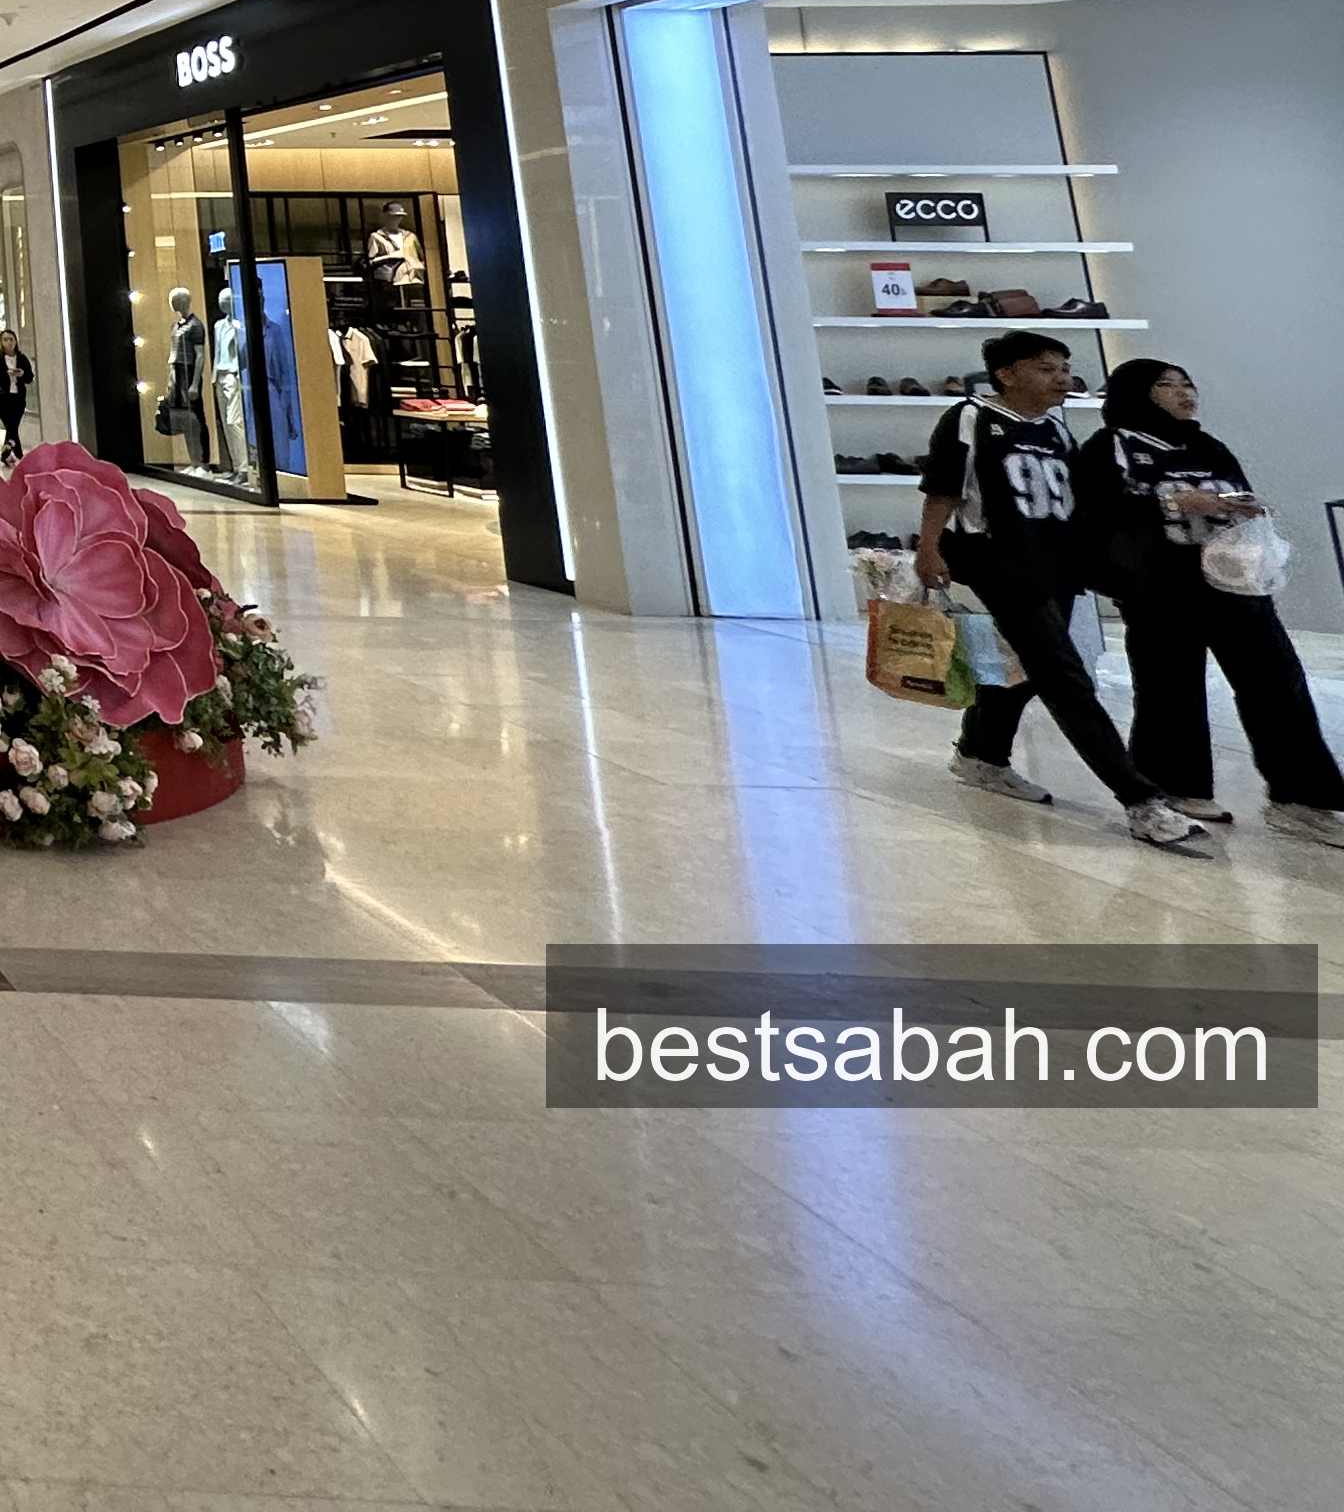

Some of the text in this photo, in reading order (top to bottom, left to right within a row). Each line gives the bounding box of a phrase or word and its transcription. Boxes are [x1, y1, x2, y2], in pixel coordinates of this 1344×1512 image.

[176, 35, 236, 88] BOSS
[895, 199, 979, 220] ecco
[1003, 452, 1076, 522] 99
